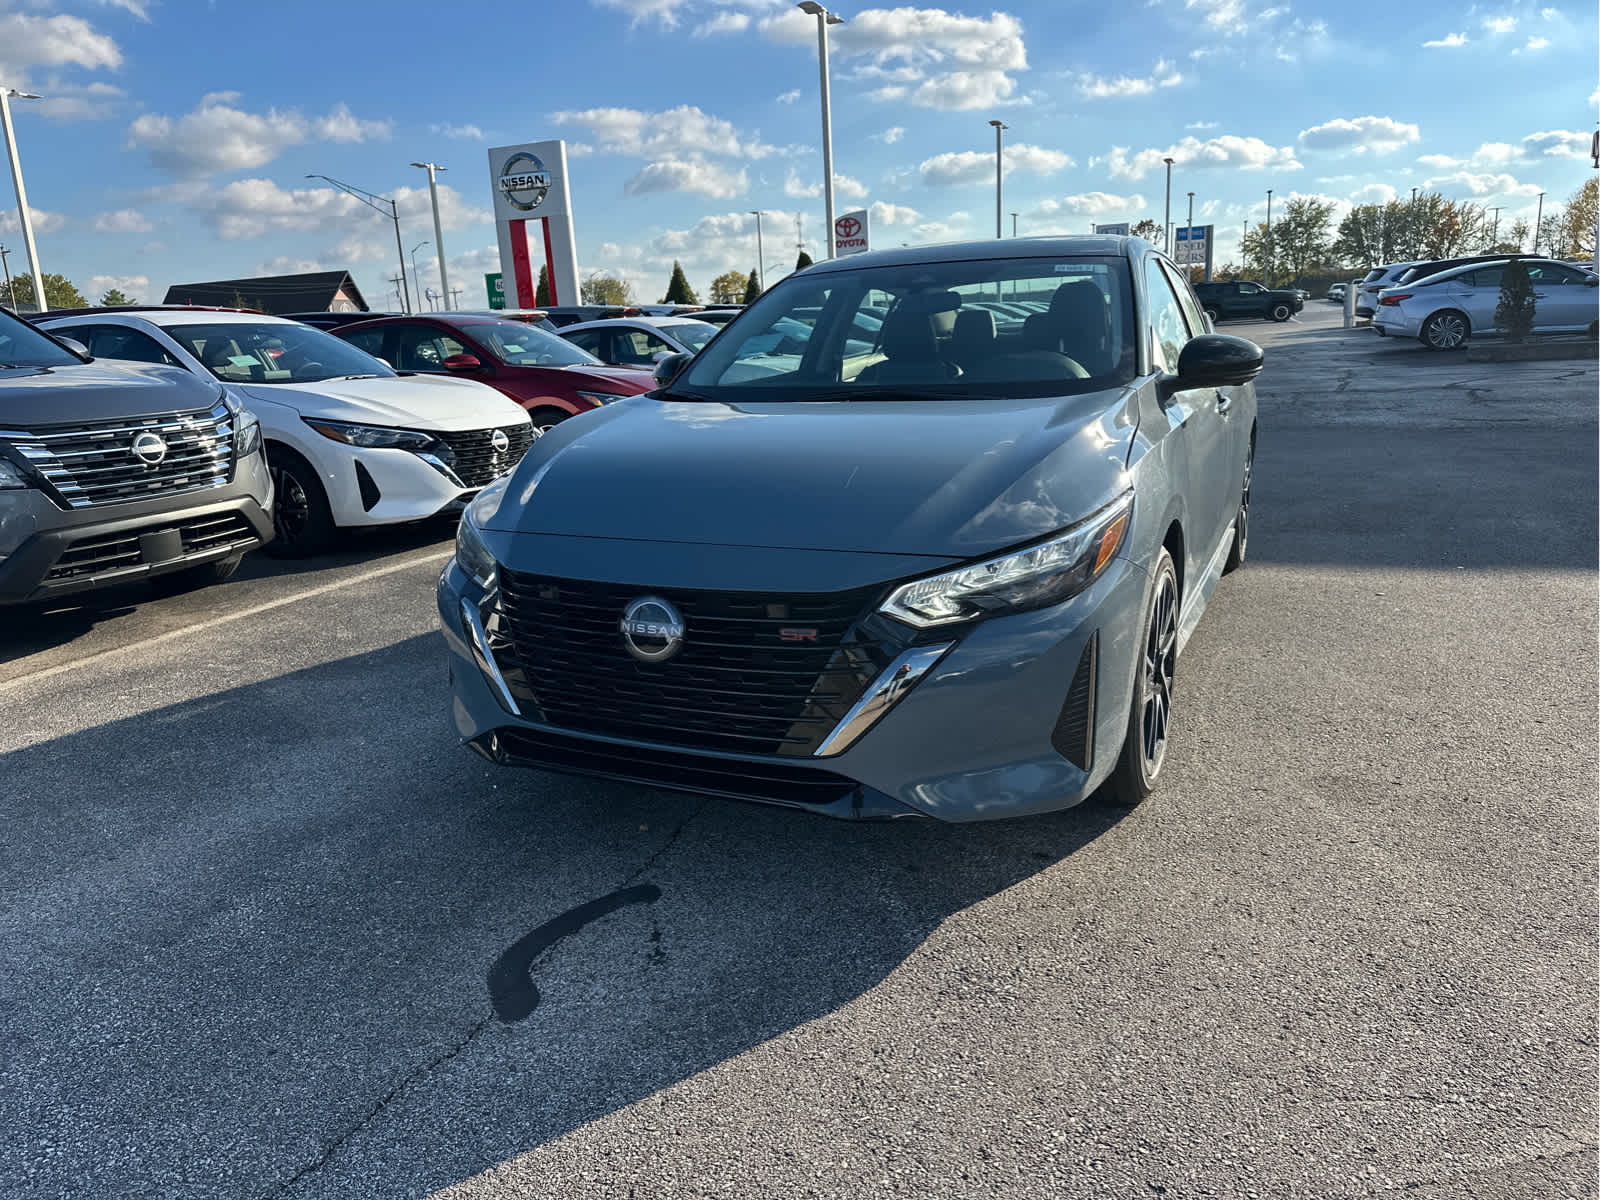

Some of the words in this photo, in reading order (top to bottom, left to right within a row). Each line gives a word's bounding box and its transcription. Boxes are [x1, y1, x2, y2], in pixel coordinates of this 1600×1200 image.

[501, 174, 545, 188] NISSAN
[836, 238, 866, 249] OYOTA
[622, 622, 682, 636] NISSAN
[780, 628, 817, 641] SR
